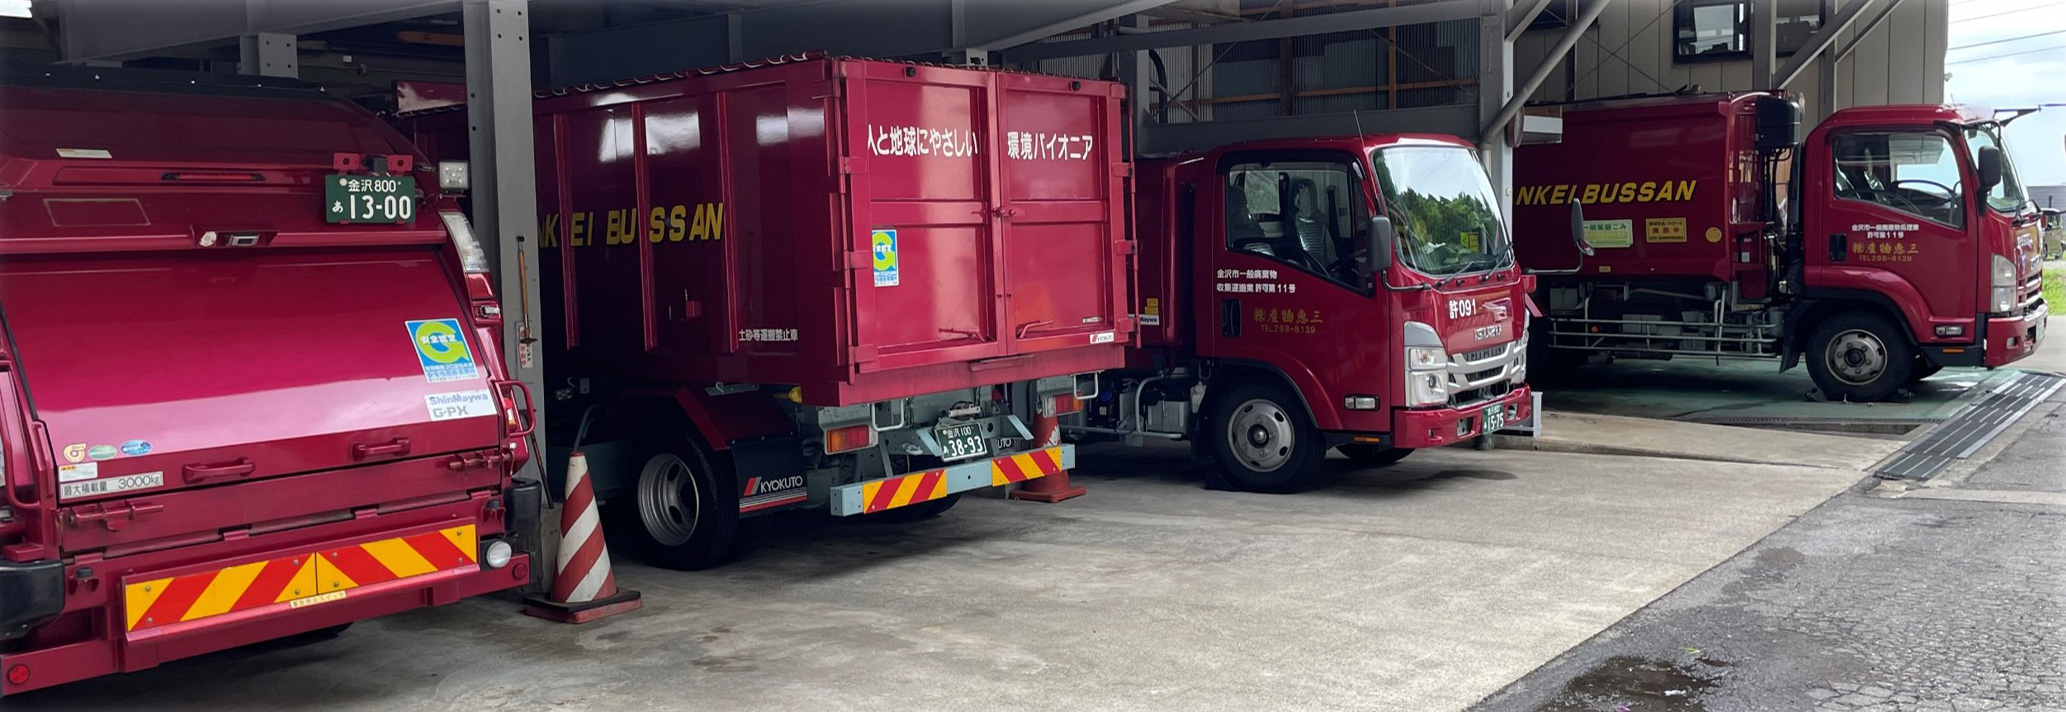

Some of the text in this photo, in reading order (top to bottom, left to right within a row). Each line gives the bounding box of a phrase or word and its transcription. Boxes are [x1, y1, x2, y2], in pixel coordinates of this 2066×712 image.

[868, 124, 1093, 160] 人と地球にやさしい 環境パイオニア
[348, 179, 396, 193] 金沢800
[1581, 180, 1697, 204] BUSSAN
[332, 194, 411, 219] あ 13-00
[606, 202, 724, 245] BUSSAN
[1449, 298, 1476, 319] 許091
[739, 328, 798, 341] 土砂等運搬禁止車
[429, 392, 488, 405] ShinMaywa
[948, 436, 983, 457] 38-93
[64, 475, 160, 497] 最大積載量 3000kg
[760, 475, 803, 493] KYOKUTO
